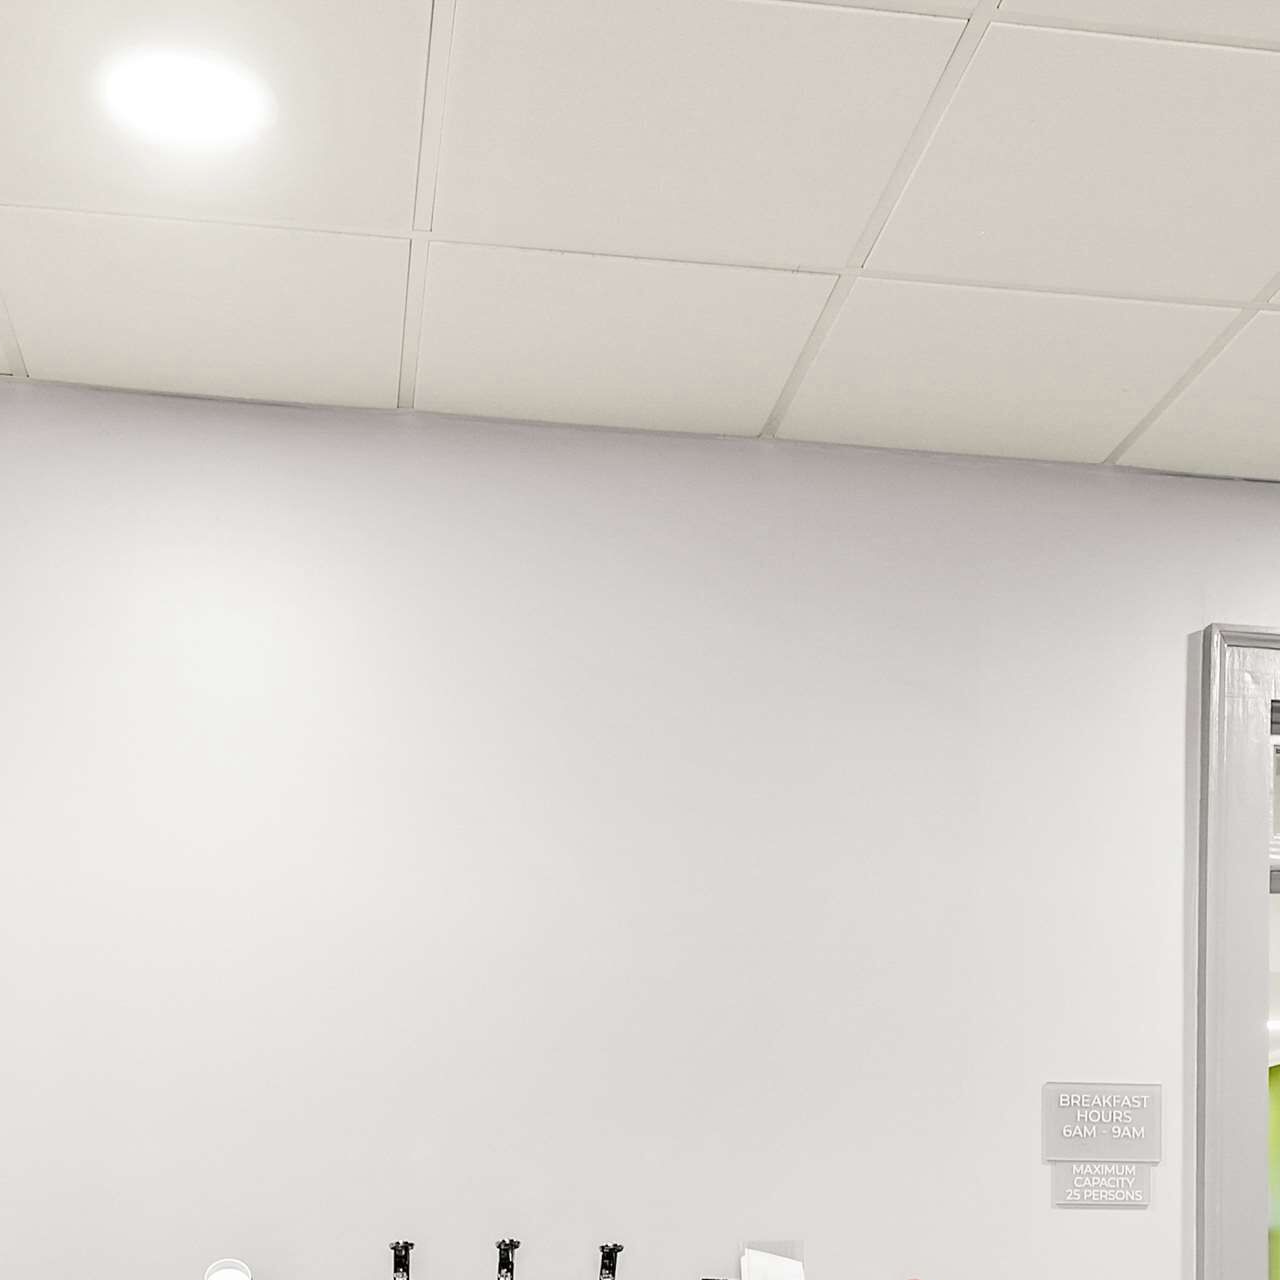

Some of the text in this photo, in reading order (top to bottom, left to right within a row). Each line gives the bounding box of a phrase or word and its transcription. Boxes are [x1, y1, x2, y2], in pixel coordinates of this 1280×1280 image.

[1059, 1093, 1150, 1108] BREAKFAST
[1077, 1109, 1132, 1123] HOURS
[1062, 1124, 1097, 1138] 6AM
[1111, 1125, 1145, 1139] 9AM
[1072, 1164, 1136, 1176] MAXIMUM
[1073, 1176, 1136, 1188] CAPACITY
[1065, 1188, 1143, 1201] 25 PERSONS
